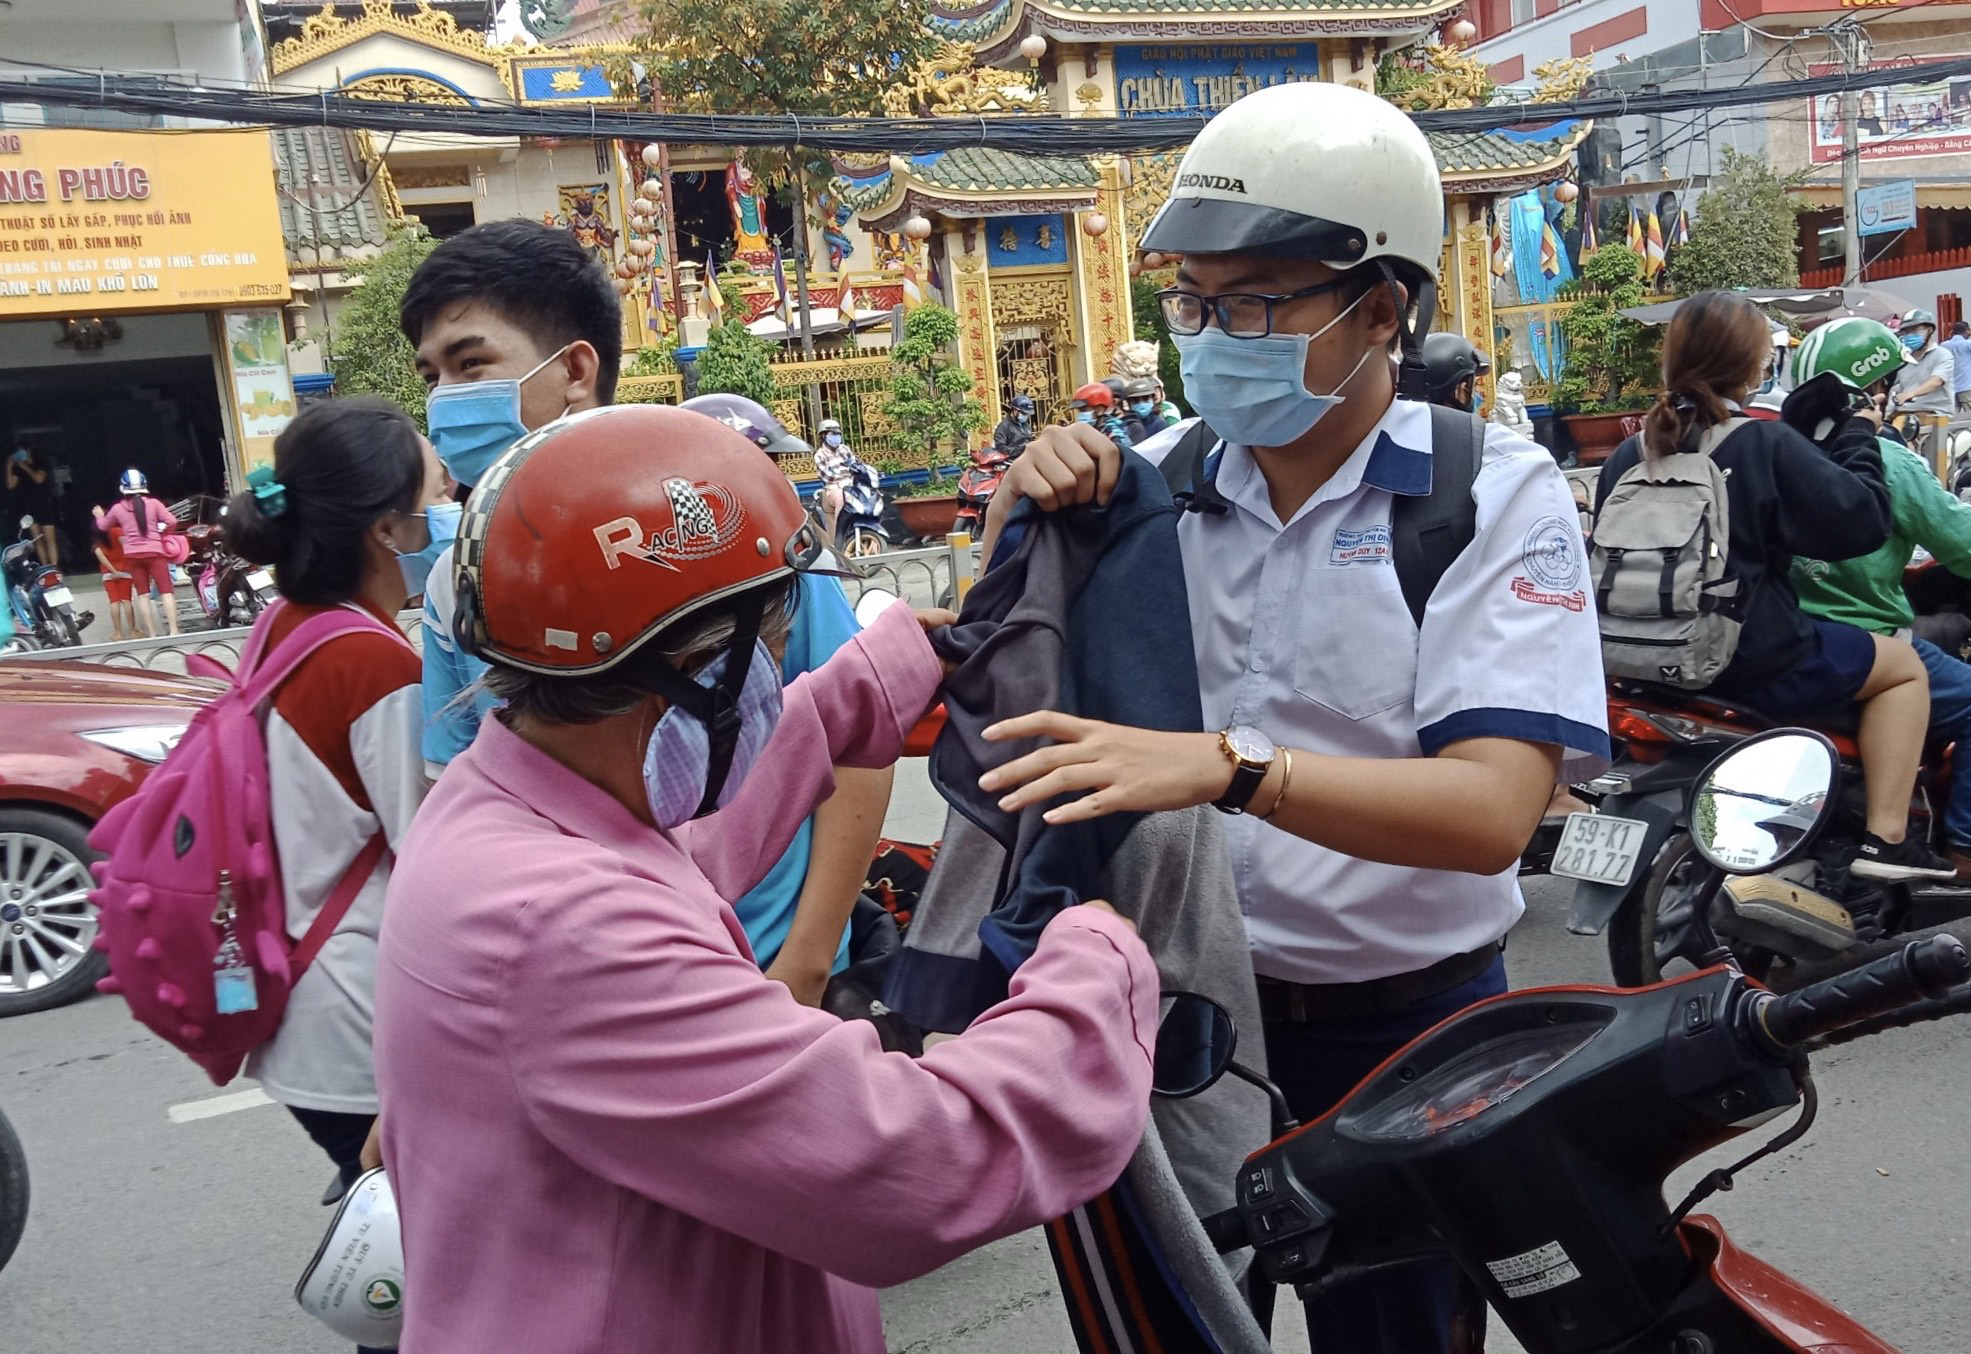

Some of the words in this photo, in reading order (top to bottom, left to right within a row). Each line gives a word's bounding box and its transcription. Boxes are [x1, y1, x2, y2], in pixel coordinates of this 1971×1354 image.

[1274, 46, 1297, 57] NAM
[58, 160, 151, 201] PHÚC
[1177, 173, 1248, 194] HONDA
[1850, 346, 1892, 378] Grab
[592, 514, 711, 573] RACING
[1559, 845, 1631, 880] 281.77
